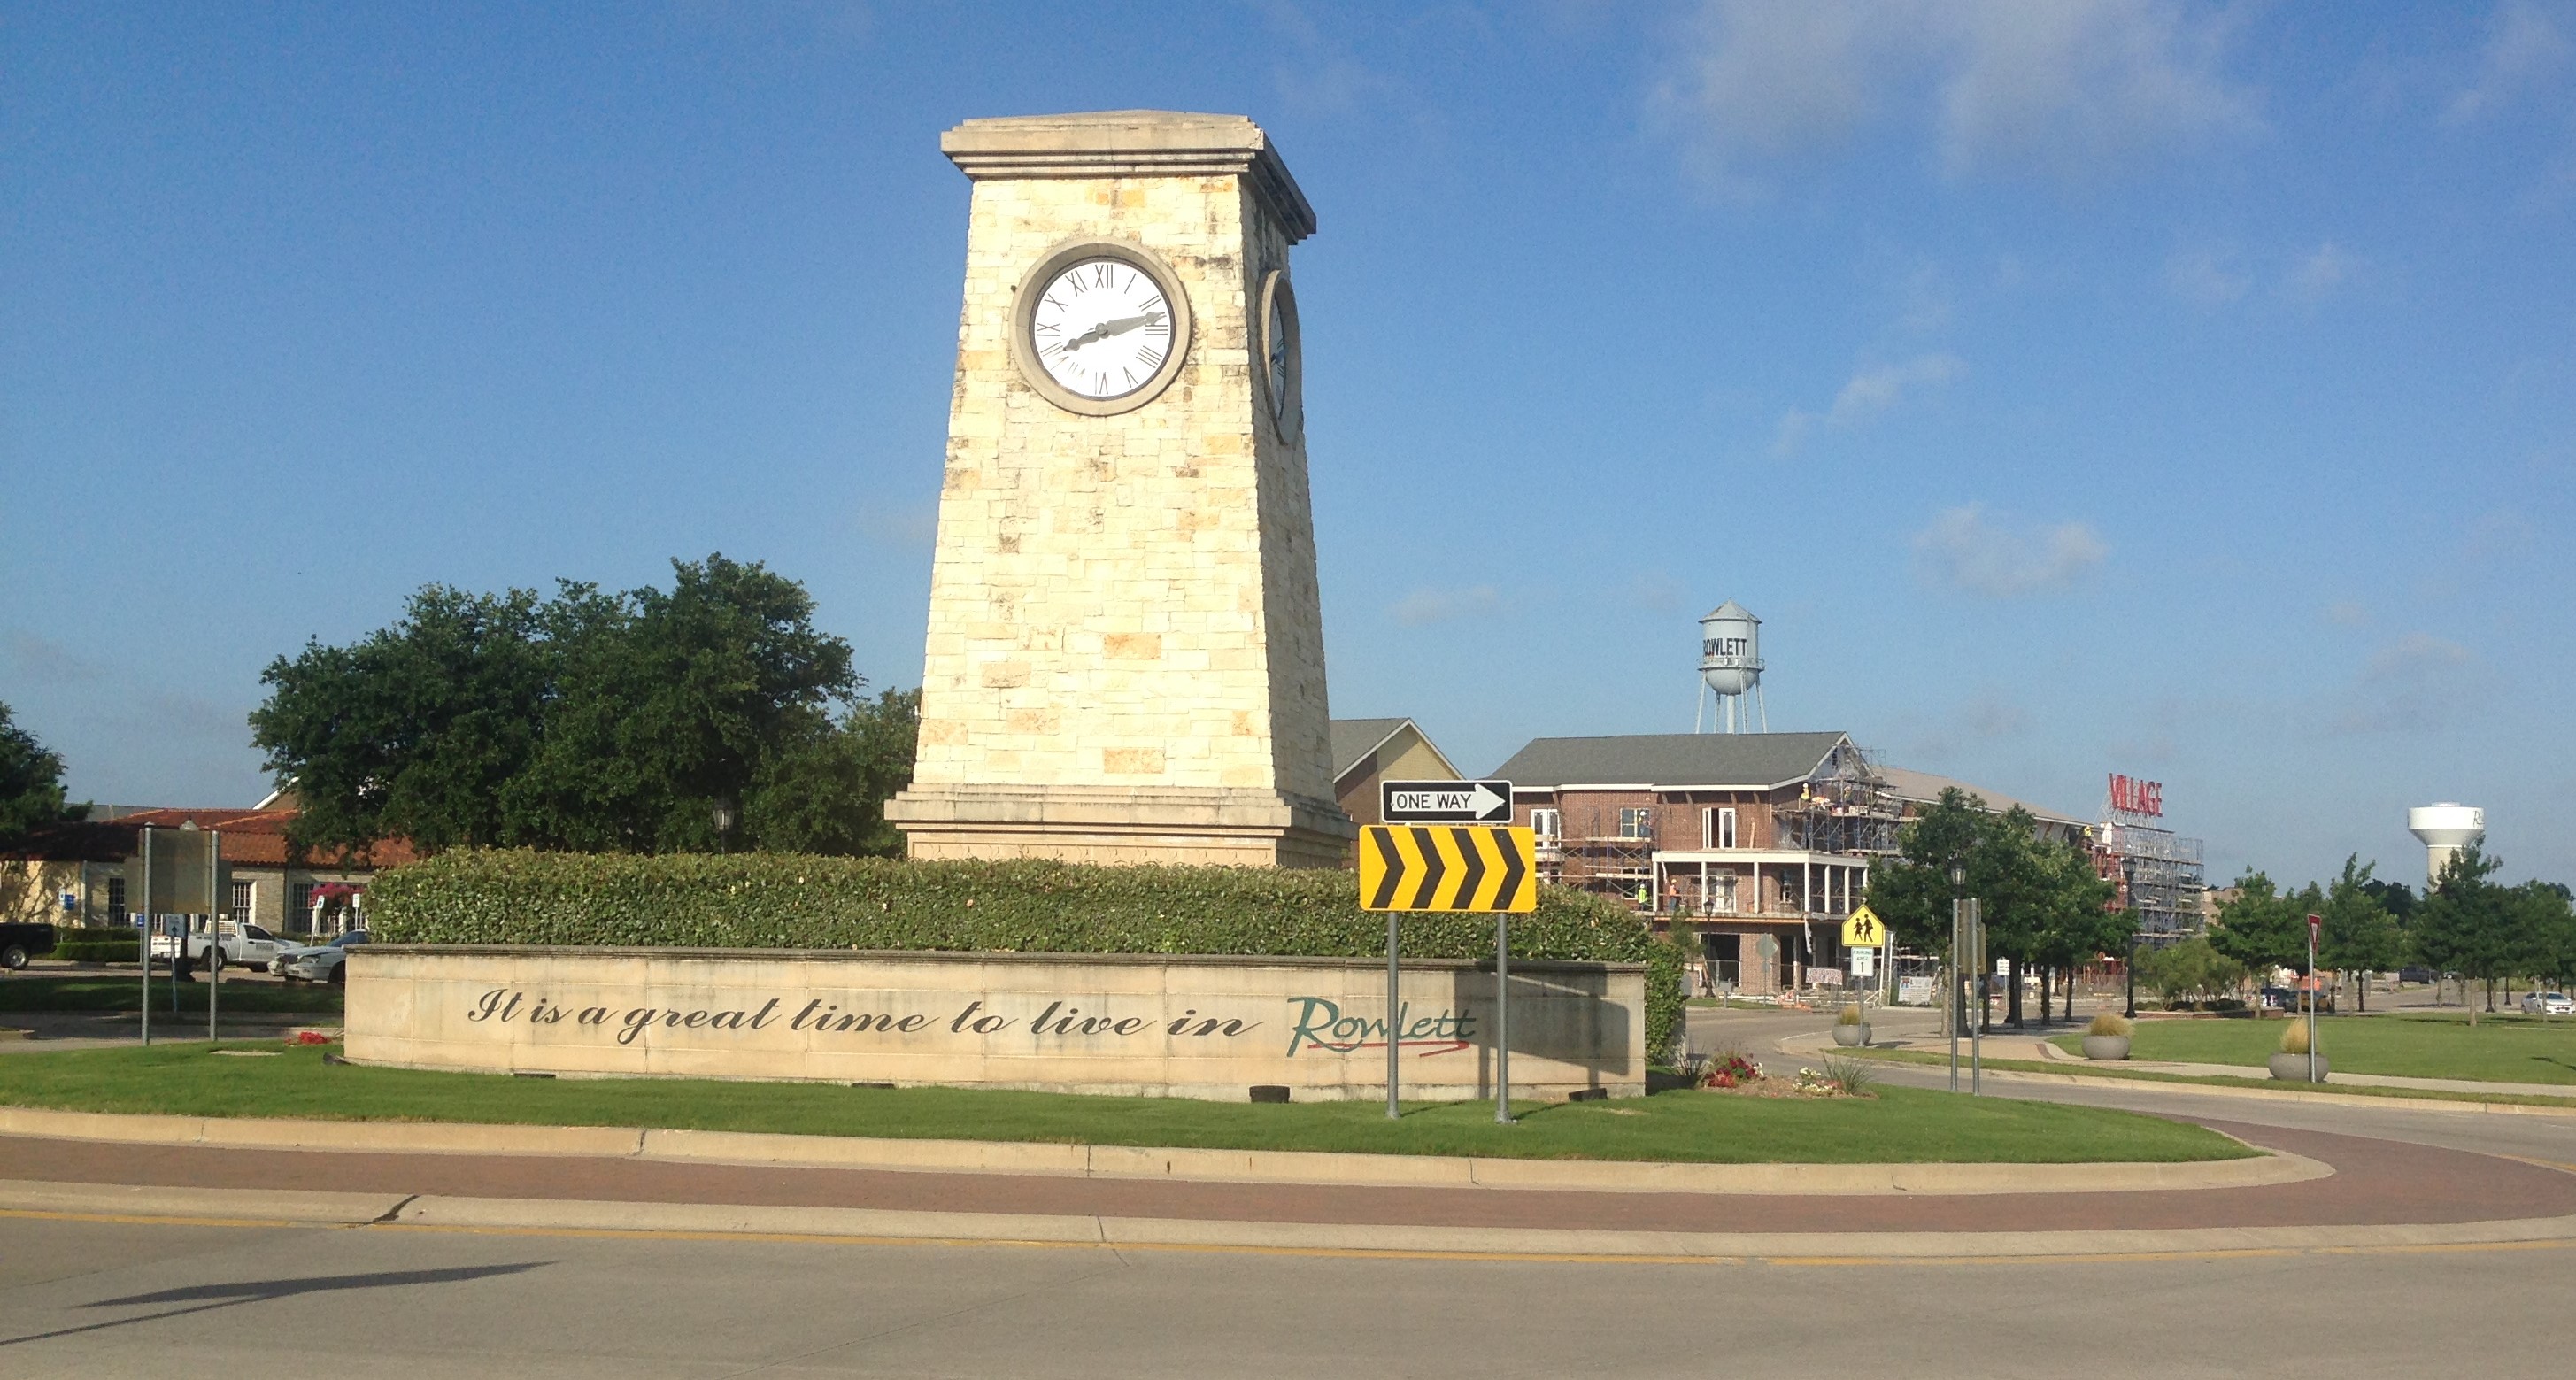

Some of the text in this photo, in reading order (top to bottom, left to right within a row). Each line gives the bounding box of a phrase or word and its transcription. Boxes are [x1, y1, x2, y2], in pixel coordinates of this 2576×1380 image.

[1065, 269, 1089, 297] XI
[1095, 264, 1114, 289] XII
[1396, 793, 1472, 810] ONE WAY
[2109, 772, 2163, 817] VILLAGE
[467, 987, 1477, 1058] It is a great time to live in Rowlett
